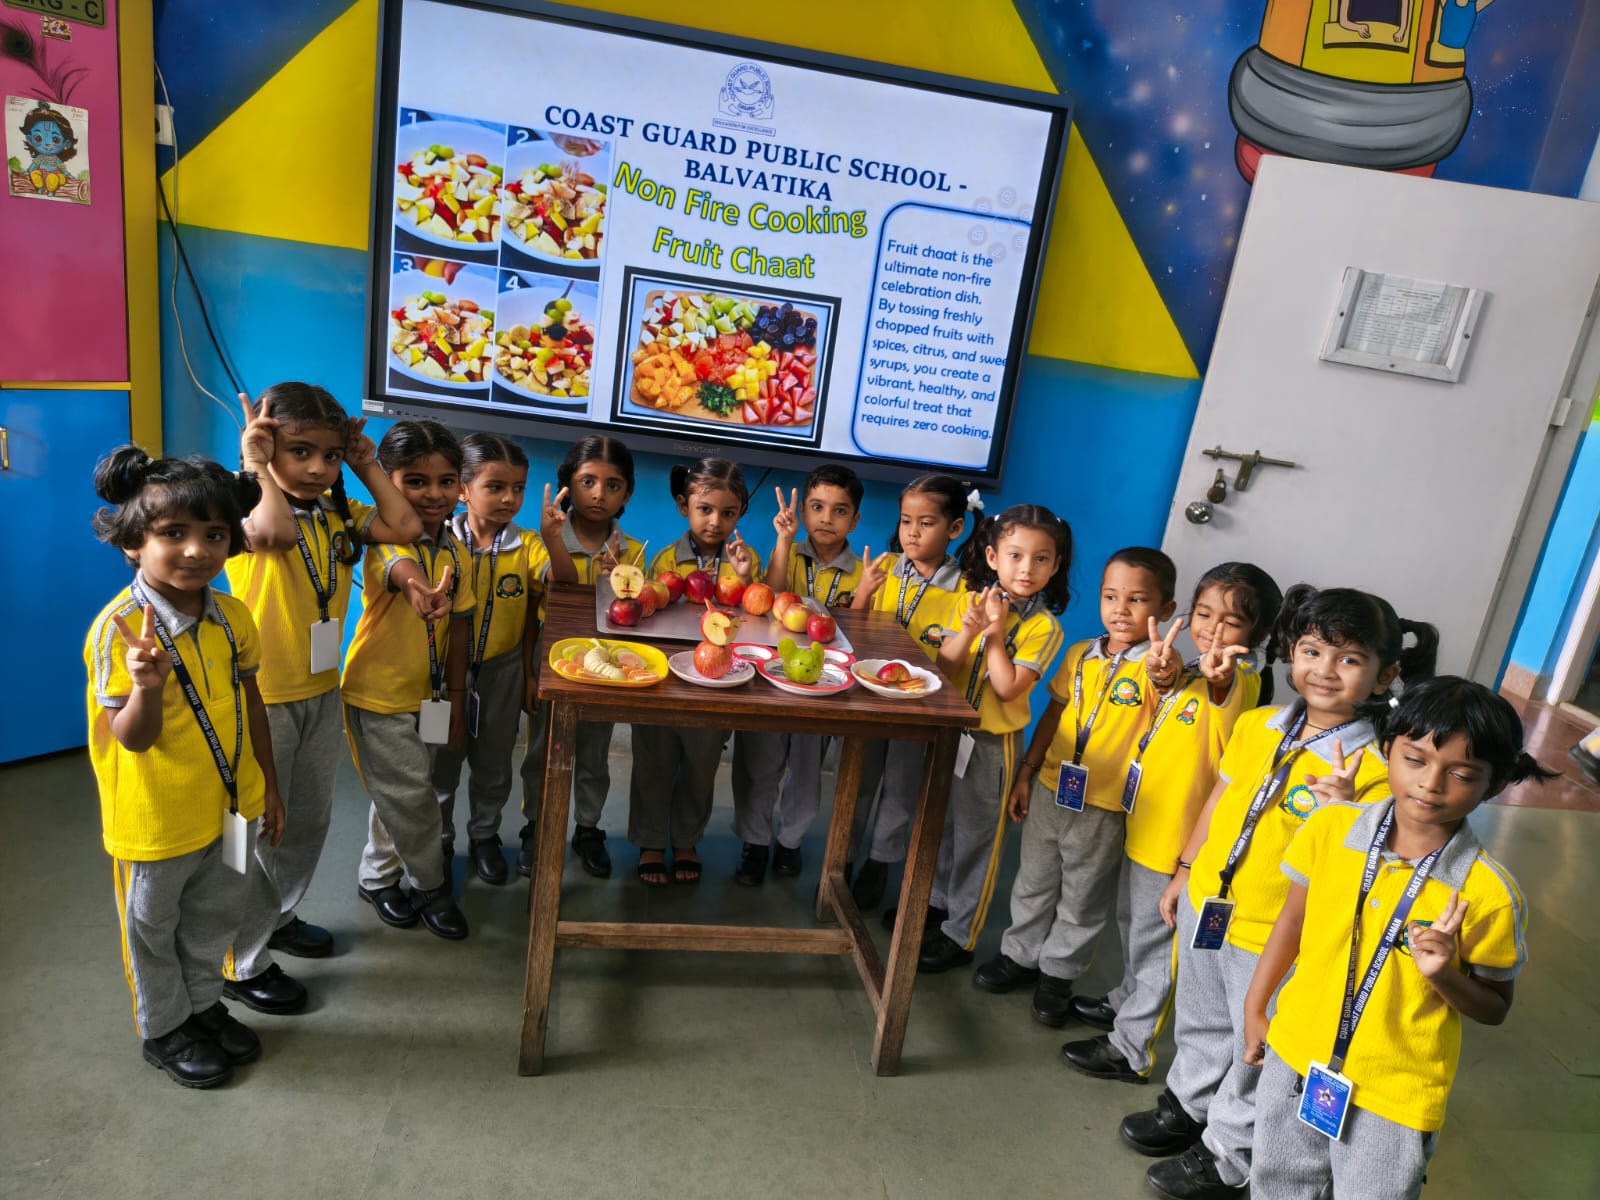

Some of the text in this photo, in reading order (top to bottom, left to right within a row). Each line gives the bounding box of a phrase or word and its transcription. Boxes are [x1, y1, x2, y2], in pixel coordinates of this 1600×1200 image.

[84, 0, 99, 19] C
[407, 112, 419, 129] 1
[516, 129, 529, 145] 2
[545, 105, 634, 137] COAST
[642, 123, 737, 155] GUARD
[745, 139, 842, 173] PUBLIC
[848, 158, 951, 192] SCHOOL
[684, 159, 833, 202] BALVATIKA
[613, 161, 868, 238] Non Fire Cooking
[653, 227, 815, 278] Fruit Chaat
[887, 239, 993, 267] Fruit chaat is the
[400, 259, 413, 273] 3
[884, 261, 992, 287] ultimate non-fire
[506, 275, 520, 291] 4
[881, 281, 982, 305] celebration dish.
[879, 298, 983, 327] By tossing freshly
[875, 318, 994, 346] chopped fruits with
[872, 338, 909, 354] spices,
[913, 343, 948, 359] citrus,
[952, 350, 976, 362] and
[869, 357, 991, 382] syrups, you create a
[867, 375, 996, 402] vibrant, healthy, and
[864, 395, 972, 418] colorful treat that
[861, 412, 992, 440] requires zero cooking.
[1374, 825, 1389, 846] PUBLIC
[1368, 846, 1380, 870] GUARD
[1362, 870, 1376, 892] COAST
[1406, 875, 1423, 898] COAST
[1417, 856, 1434, 877] GUARD
[1354, 988, 1369, 1013] GUARD
[1363, 968, 1378, 992] PUBLIC
[1373, 946, 1389, 970] SCHOOL
[1385, 918, 1402, 942] DAMAN
[1339, 1019, 1350, 1040] COAST
